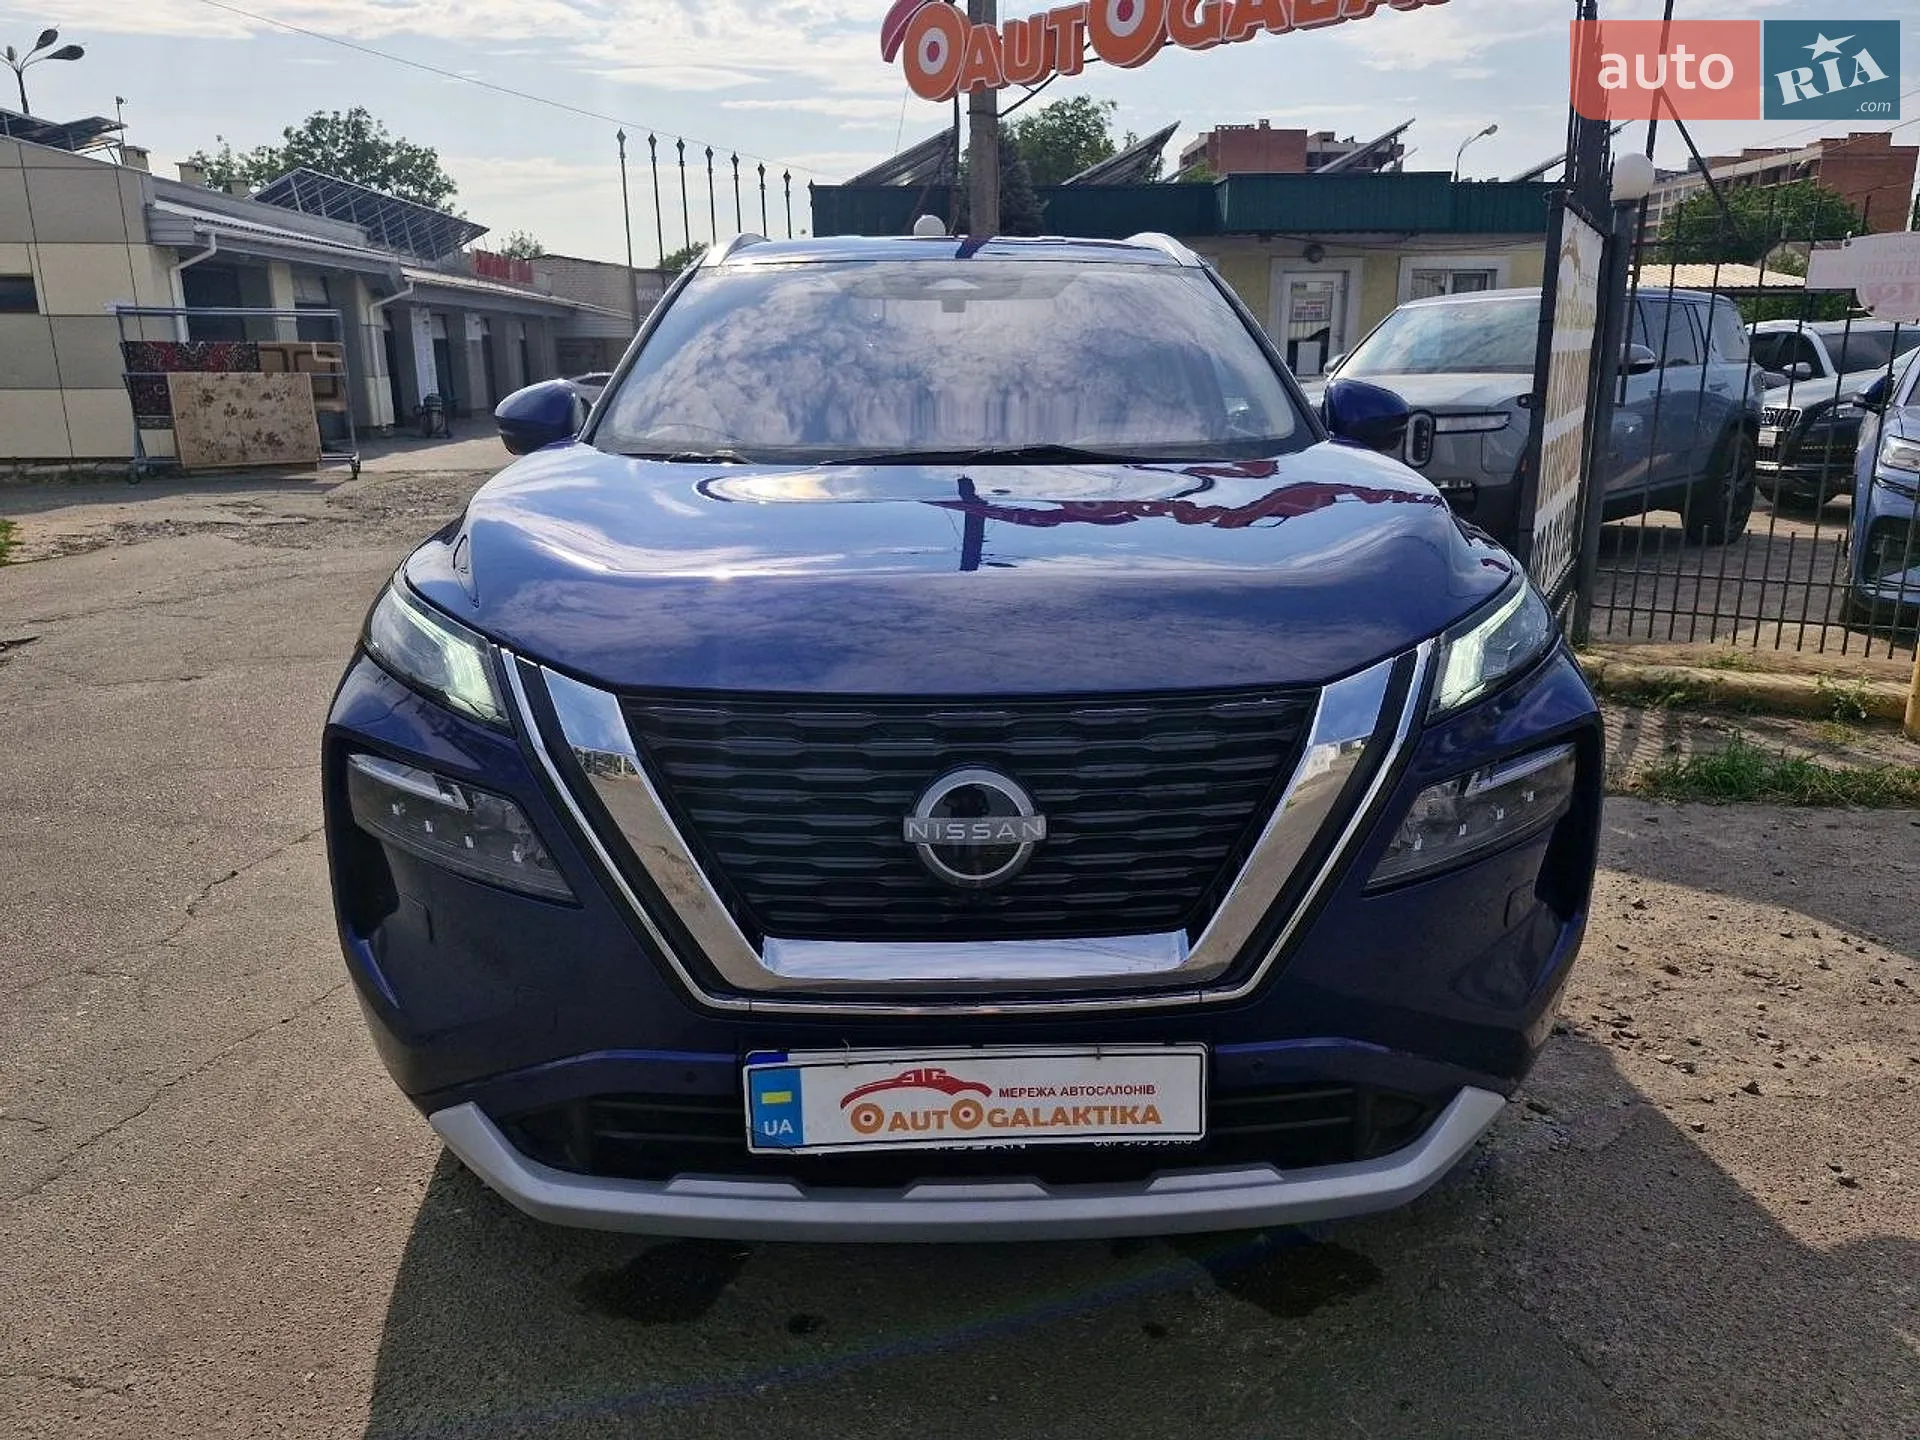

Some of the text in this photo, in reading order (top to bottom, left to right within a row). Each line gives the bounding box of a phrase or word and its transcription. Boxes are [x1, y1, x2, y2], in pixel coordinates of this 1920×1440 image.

[909, 821, 1042, 840] NISSAN
[999, 1084, 1156, 1098] МЕРЕЖА АВТОСАЛОНІВ
[764, 1120, 793, 1136] UA
